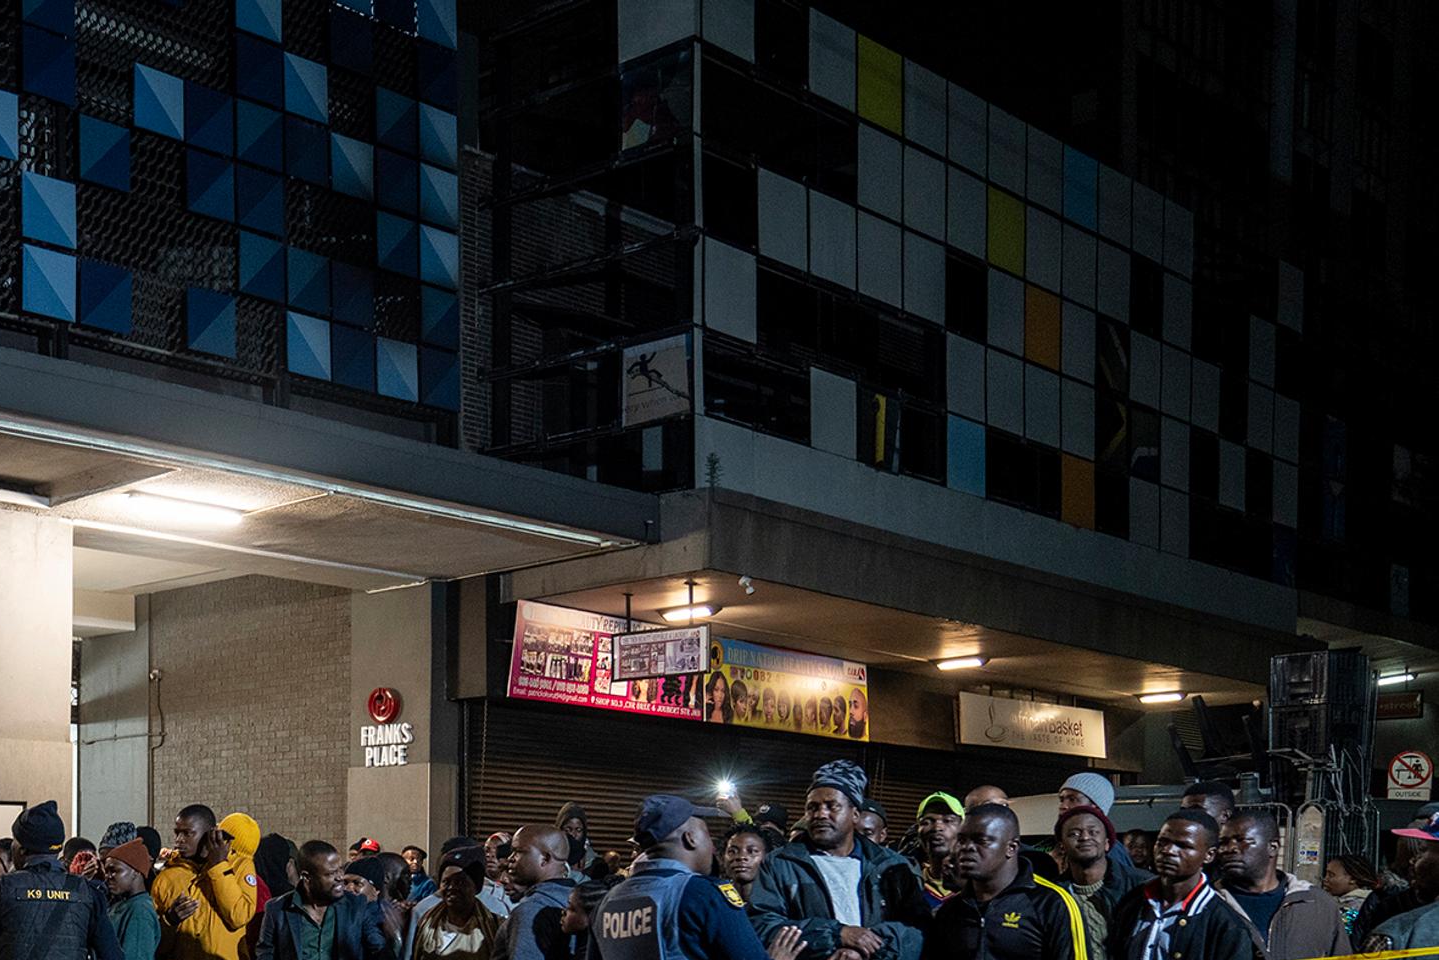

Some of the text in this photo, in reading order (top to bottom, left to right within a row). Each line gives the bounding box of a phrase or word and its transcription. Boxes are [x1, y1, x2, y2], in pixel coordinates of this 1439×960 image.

[361, 723, 413, 746] FRANKS
[365, 745, 408, 767] PLACE
[1395, 790, 1422, 798] OUTSIDE
[27, 889, 71, 900] K9 UNIT
[603, 906, 652, 939] POLICE
